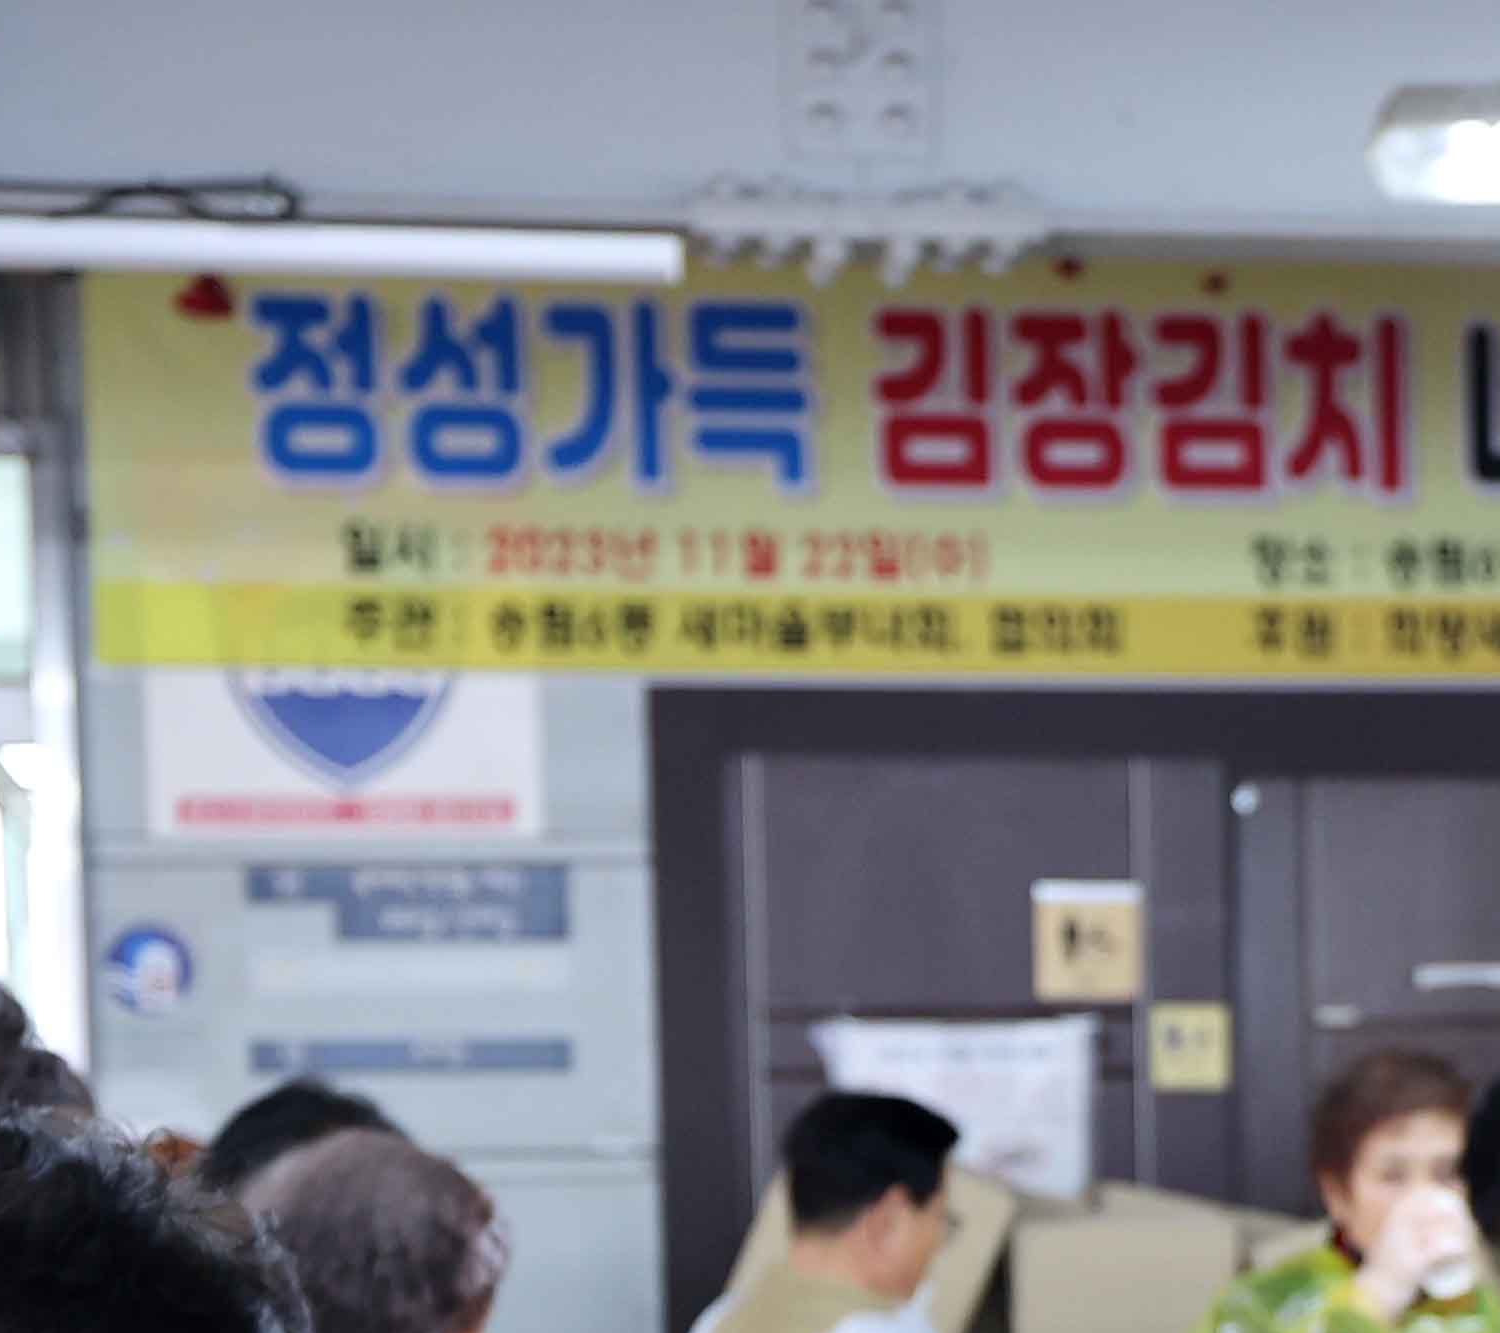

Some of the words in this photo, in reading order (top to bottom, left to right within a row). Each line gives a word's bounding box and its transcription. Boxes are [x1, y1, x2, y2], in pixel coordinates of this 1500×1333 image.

[250, 290, 808, 484] 정성가득
[875, 306, 1403, 492] 김장김치
[343, 524, 438, 574] 일시
[485, 523, 658, 582] 2023년
[678, 528, 780, 579] 11월
[1250, 534, 1332, 587] 장소
